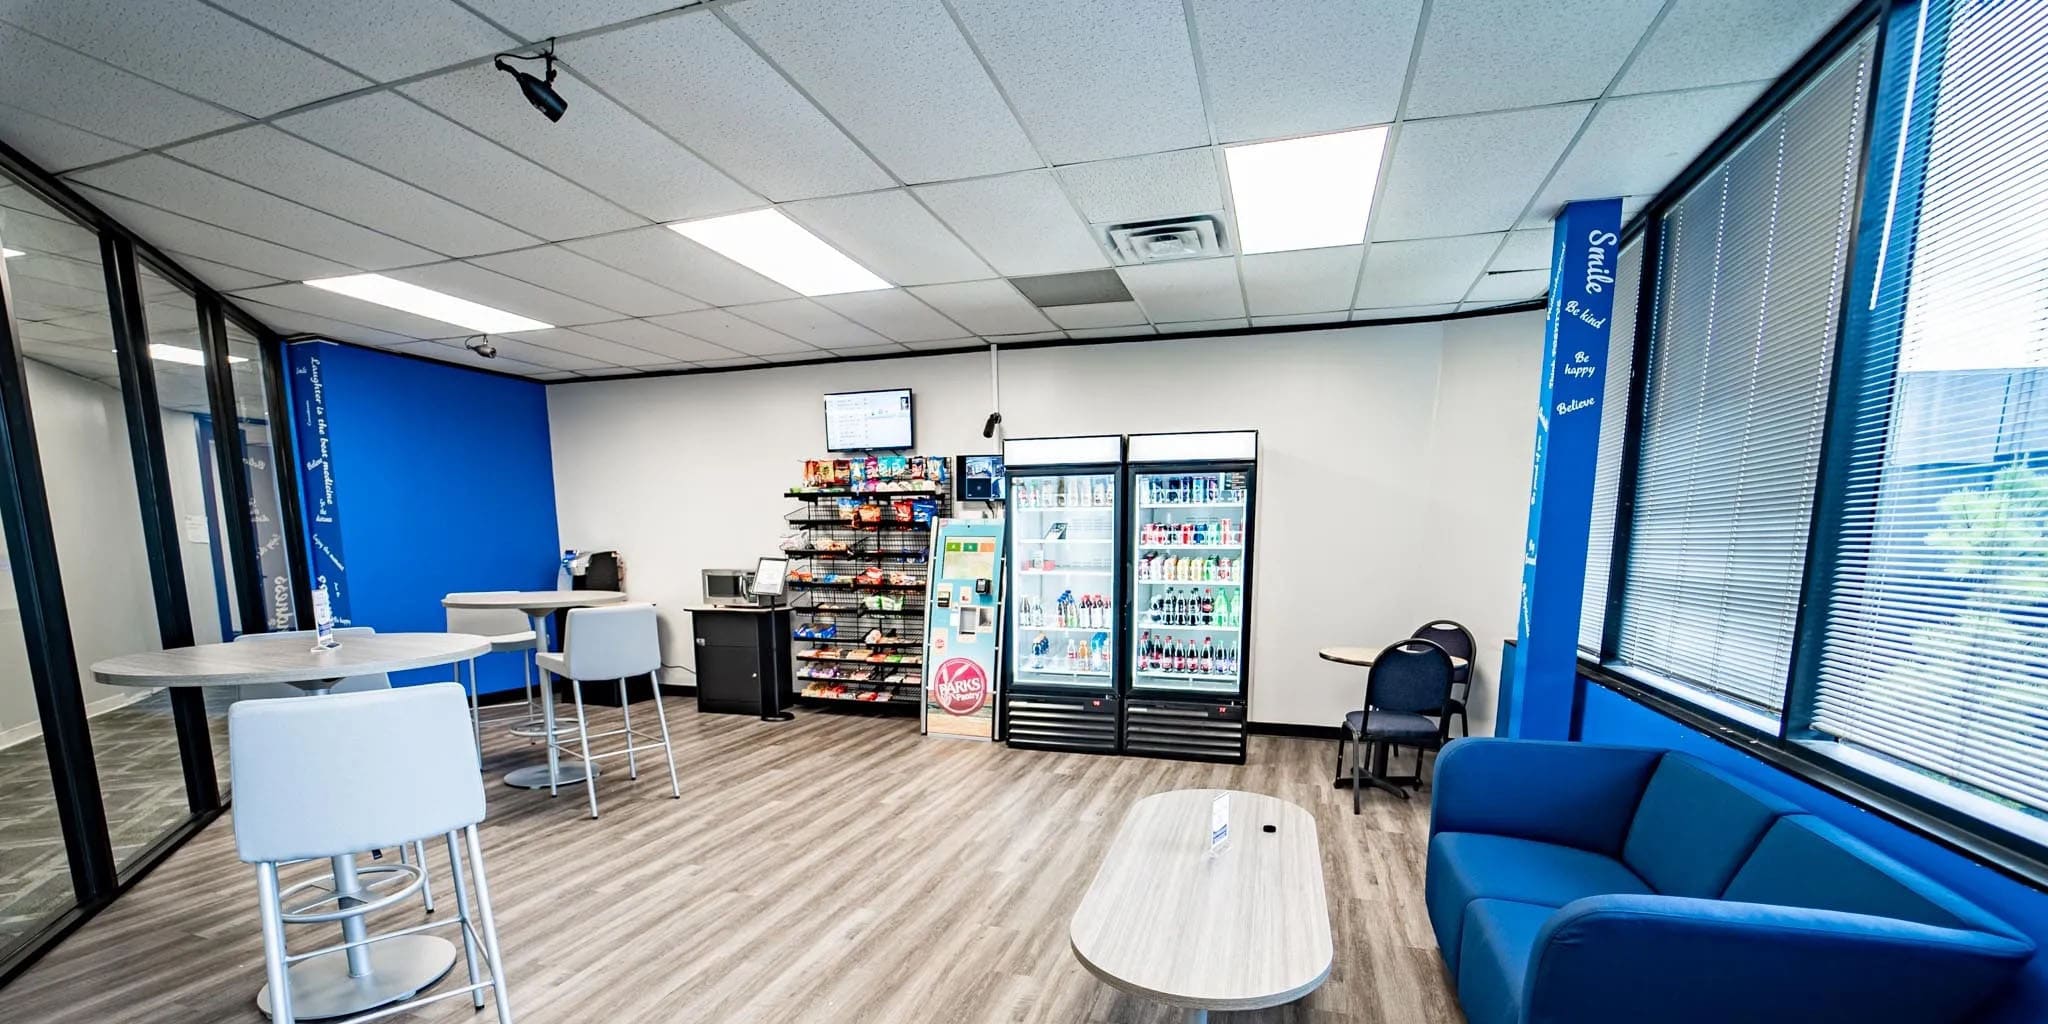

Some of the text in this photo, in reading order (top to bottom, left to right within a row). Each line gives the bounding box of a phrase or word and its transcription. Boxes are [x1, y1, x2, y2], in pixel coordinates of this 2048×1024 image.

[1585, 229, 1618, 295] Smile
[1564, 300, 1606, 329] Be kind
[1574, 351, 1590, 363] Be
[1564, 363, 1596, 378] happy
[310, 356, 323, 405] Laughter
[316, 406, 324, 416] is
[1556, 397, 1596, 415] Believe
[318, 418, 328, 435] the
[320, 437, 329, 458] best
[322, 461, 334, 505] medicine
